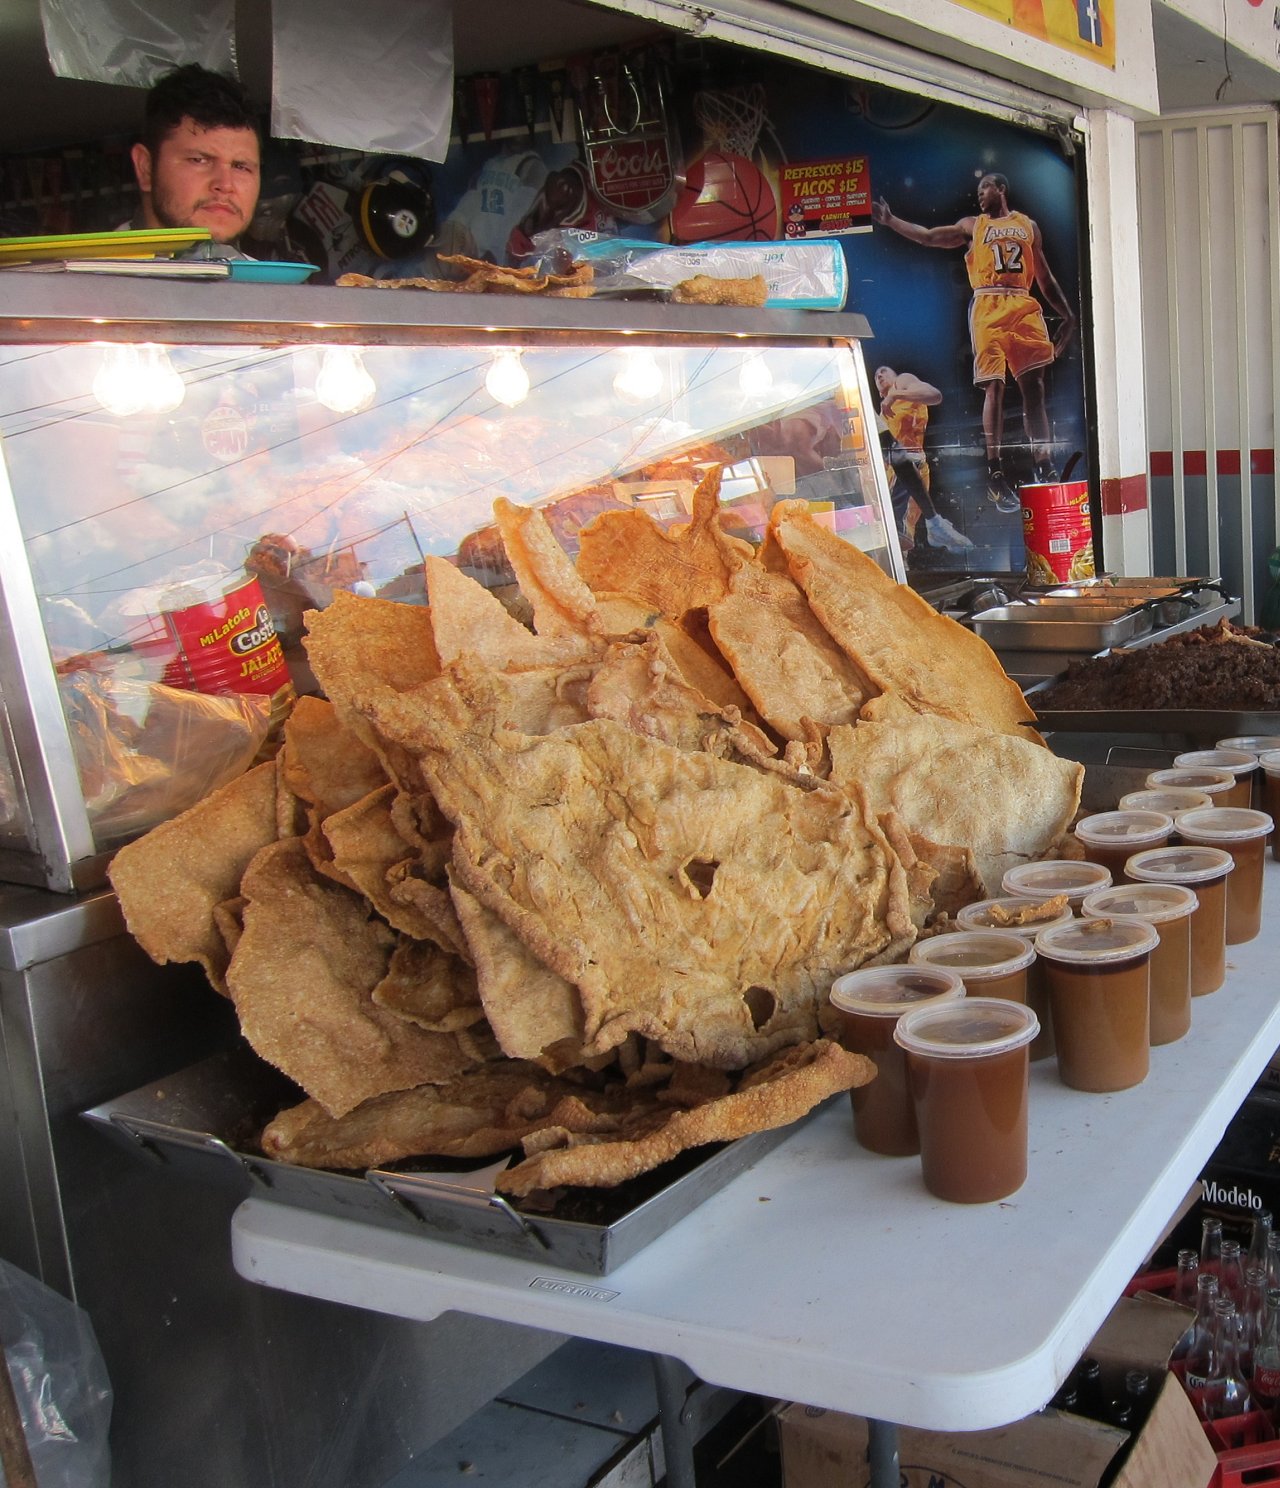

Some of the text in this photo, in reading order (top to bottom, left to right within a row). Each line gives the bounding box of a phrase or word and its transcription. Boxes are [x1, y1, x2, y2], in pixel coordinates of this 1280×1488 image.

[600, 149, 662, 179] Coors
[784, 159, 864, 180] REFRESCOS $15
[793, 178, 858, 197] TACOS $15
[480, 188, 504, 215] 12
[821, 212, 850, 221] CARNITAS
[580, 231, 596, 241] 500
[983, 225, 1028, 244] LAKERS
[991, 242, 1023, 274] 12
[1202, 1179, 1262, 1210] Modelo
